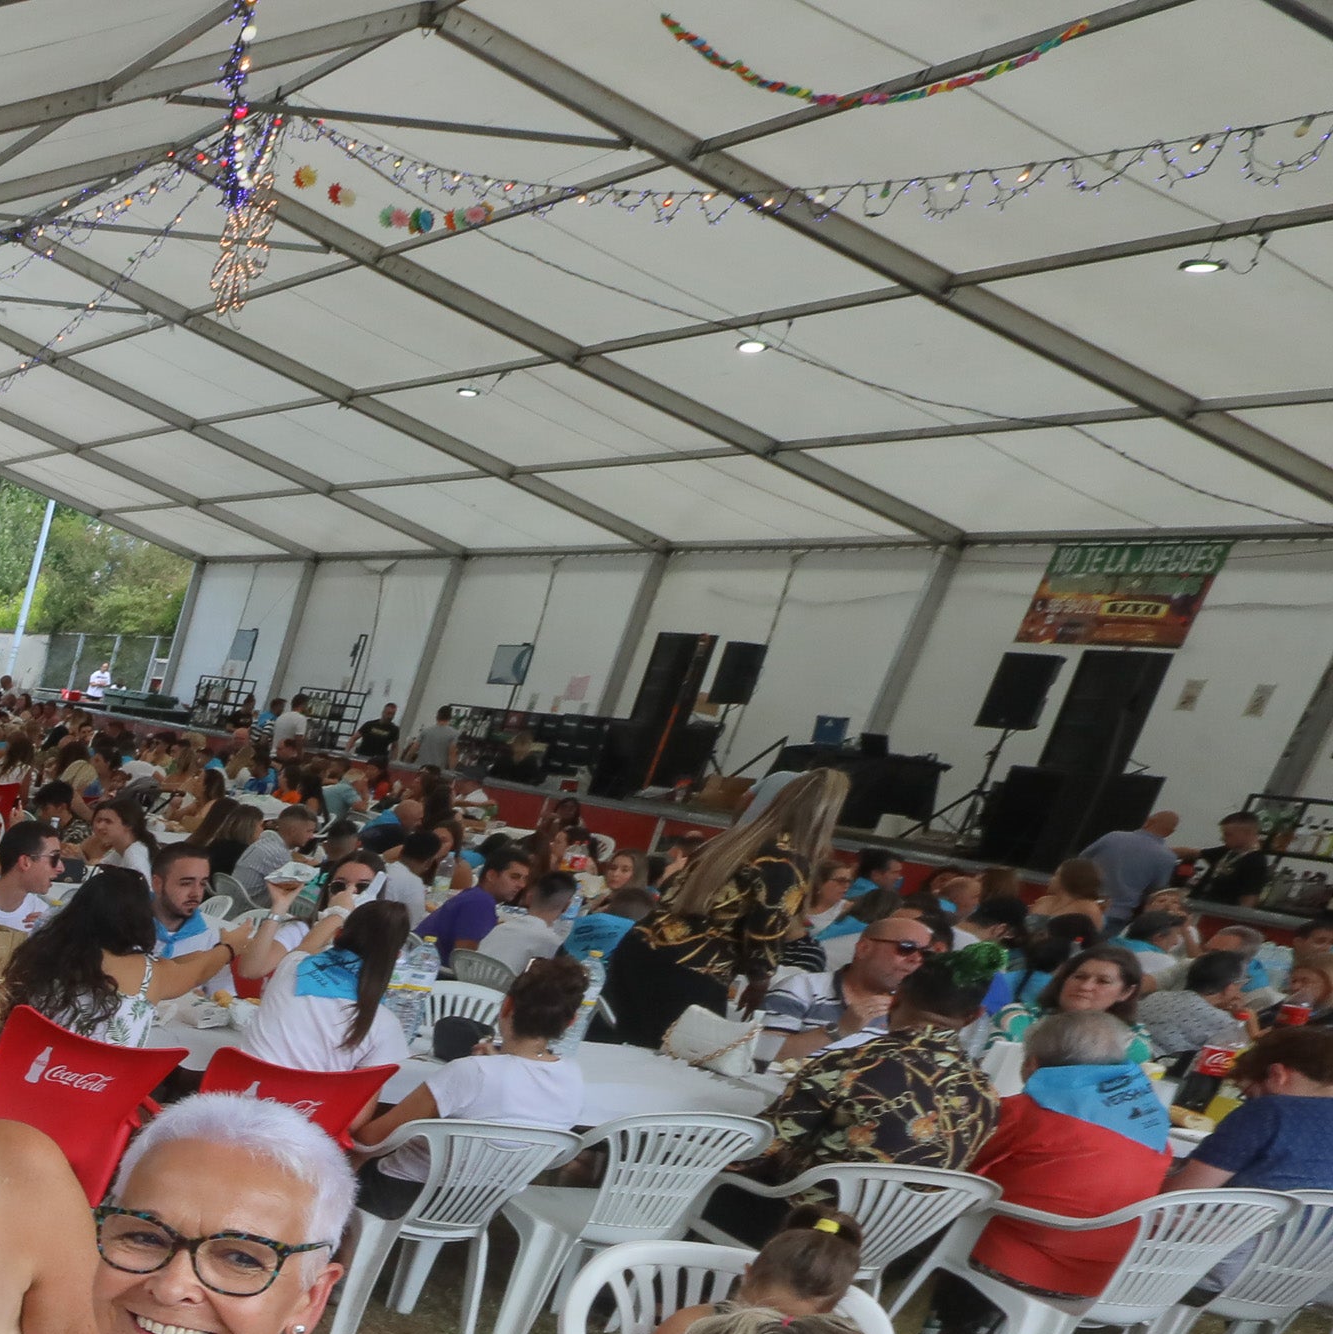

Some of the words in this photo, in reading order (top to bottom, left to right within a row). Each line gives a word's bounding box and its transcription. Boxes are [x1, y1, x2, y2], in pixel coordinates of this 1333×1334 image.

[1052, 547, 1081, 573] NO
[1103, 546, 1130, 572] LA
[1132, 544, 1224, 573] JUEGUES
